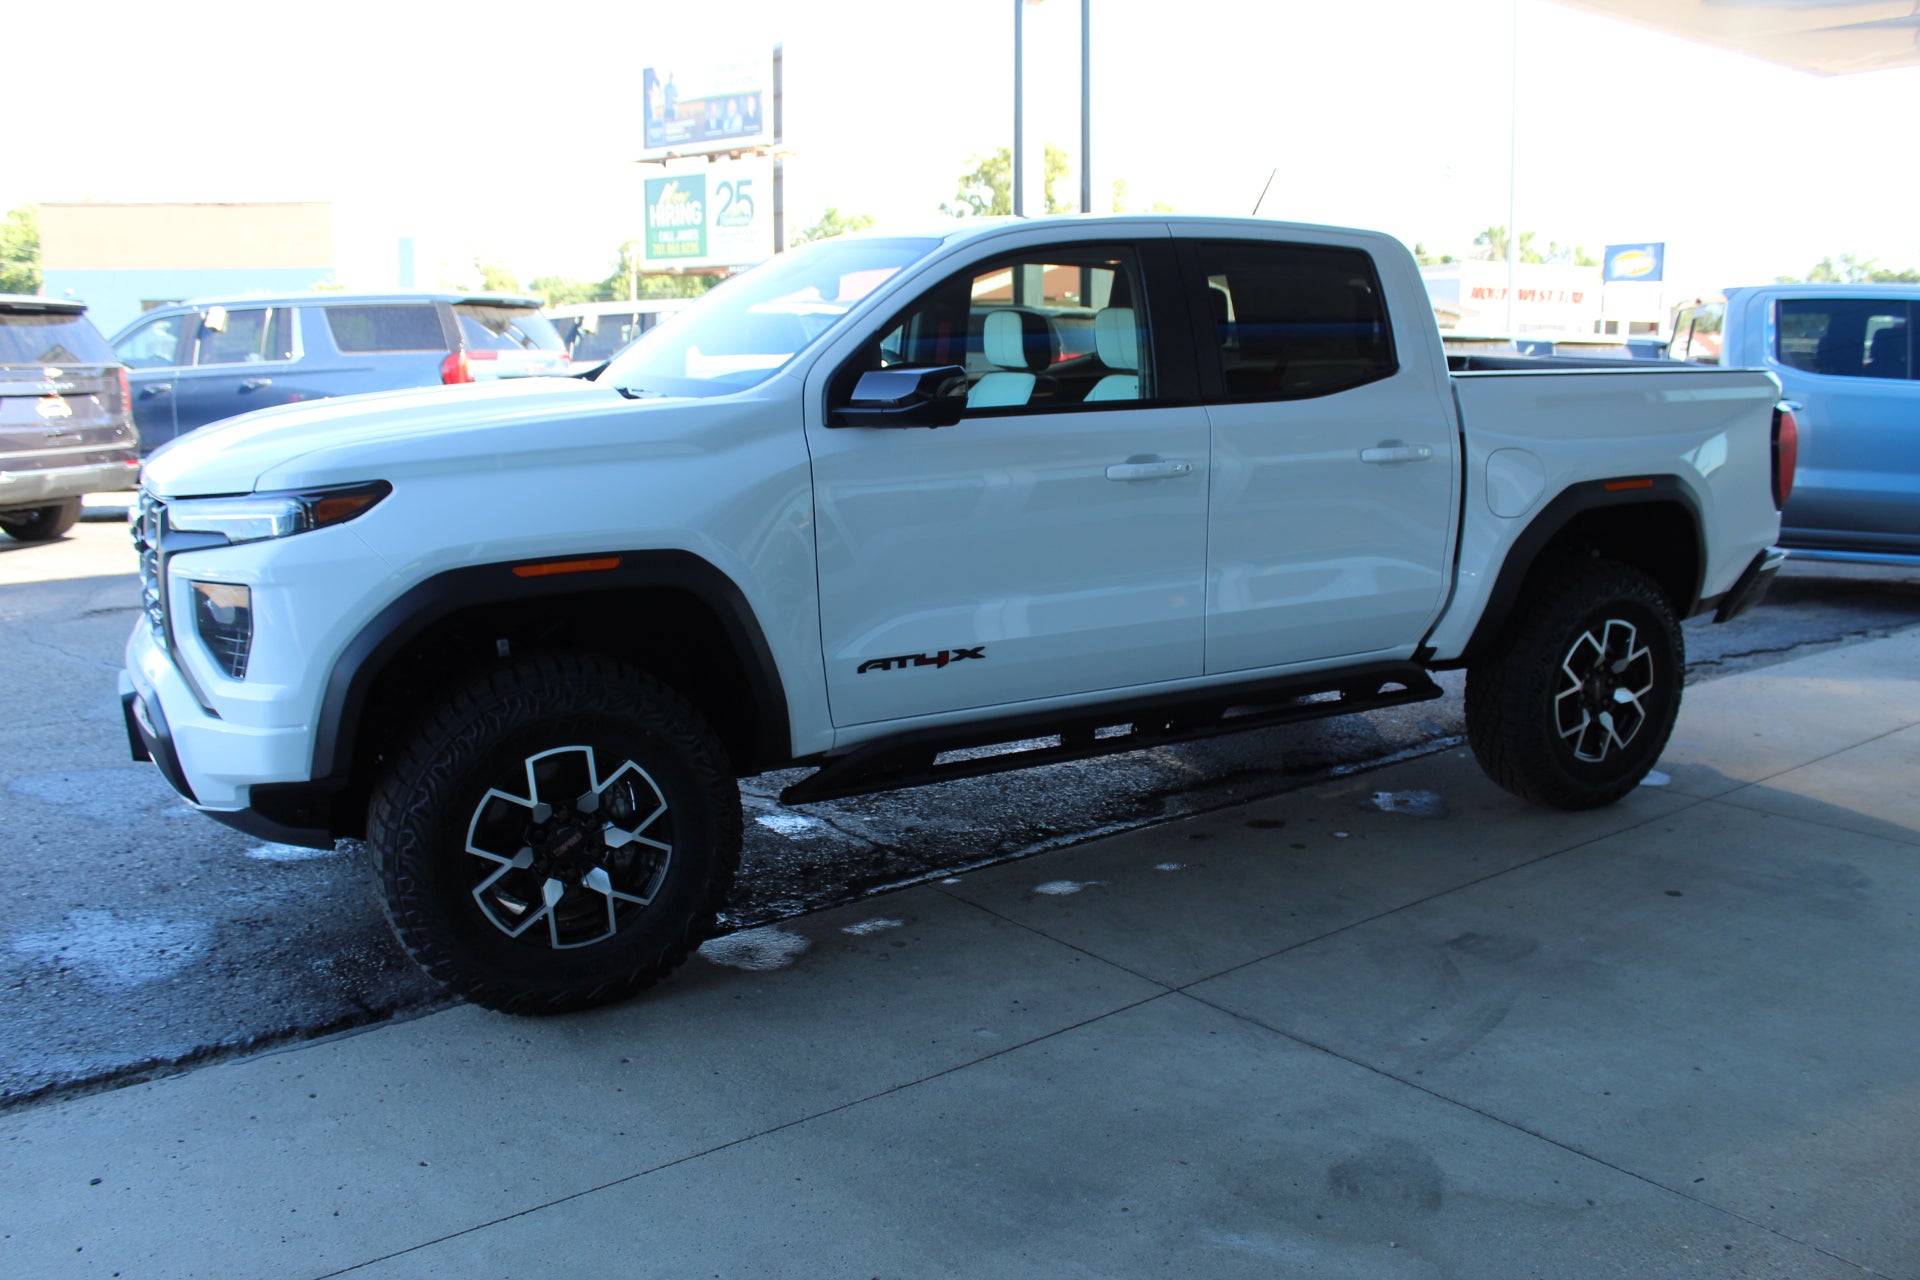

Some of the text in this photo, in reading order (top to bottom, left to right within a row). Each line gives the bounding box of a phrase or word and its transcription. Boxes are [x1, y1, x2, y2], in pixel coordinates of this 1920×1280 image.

[649, 201, 703, 228] HIRING
[715, 180, 754, 227] 25
[857, 646, 986, 674] AT4X
